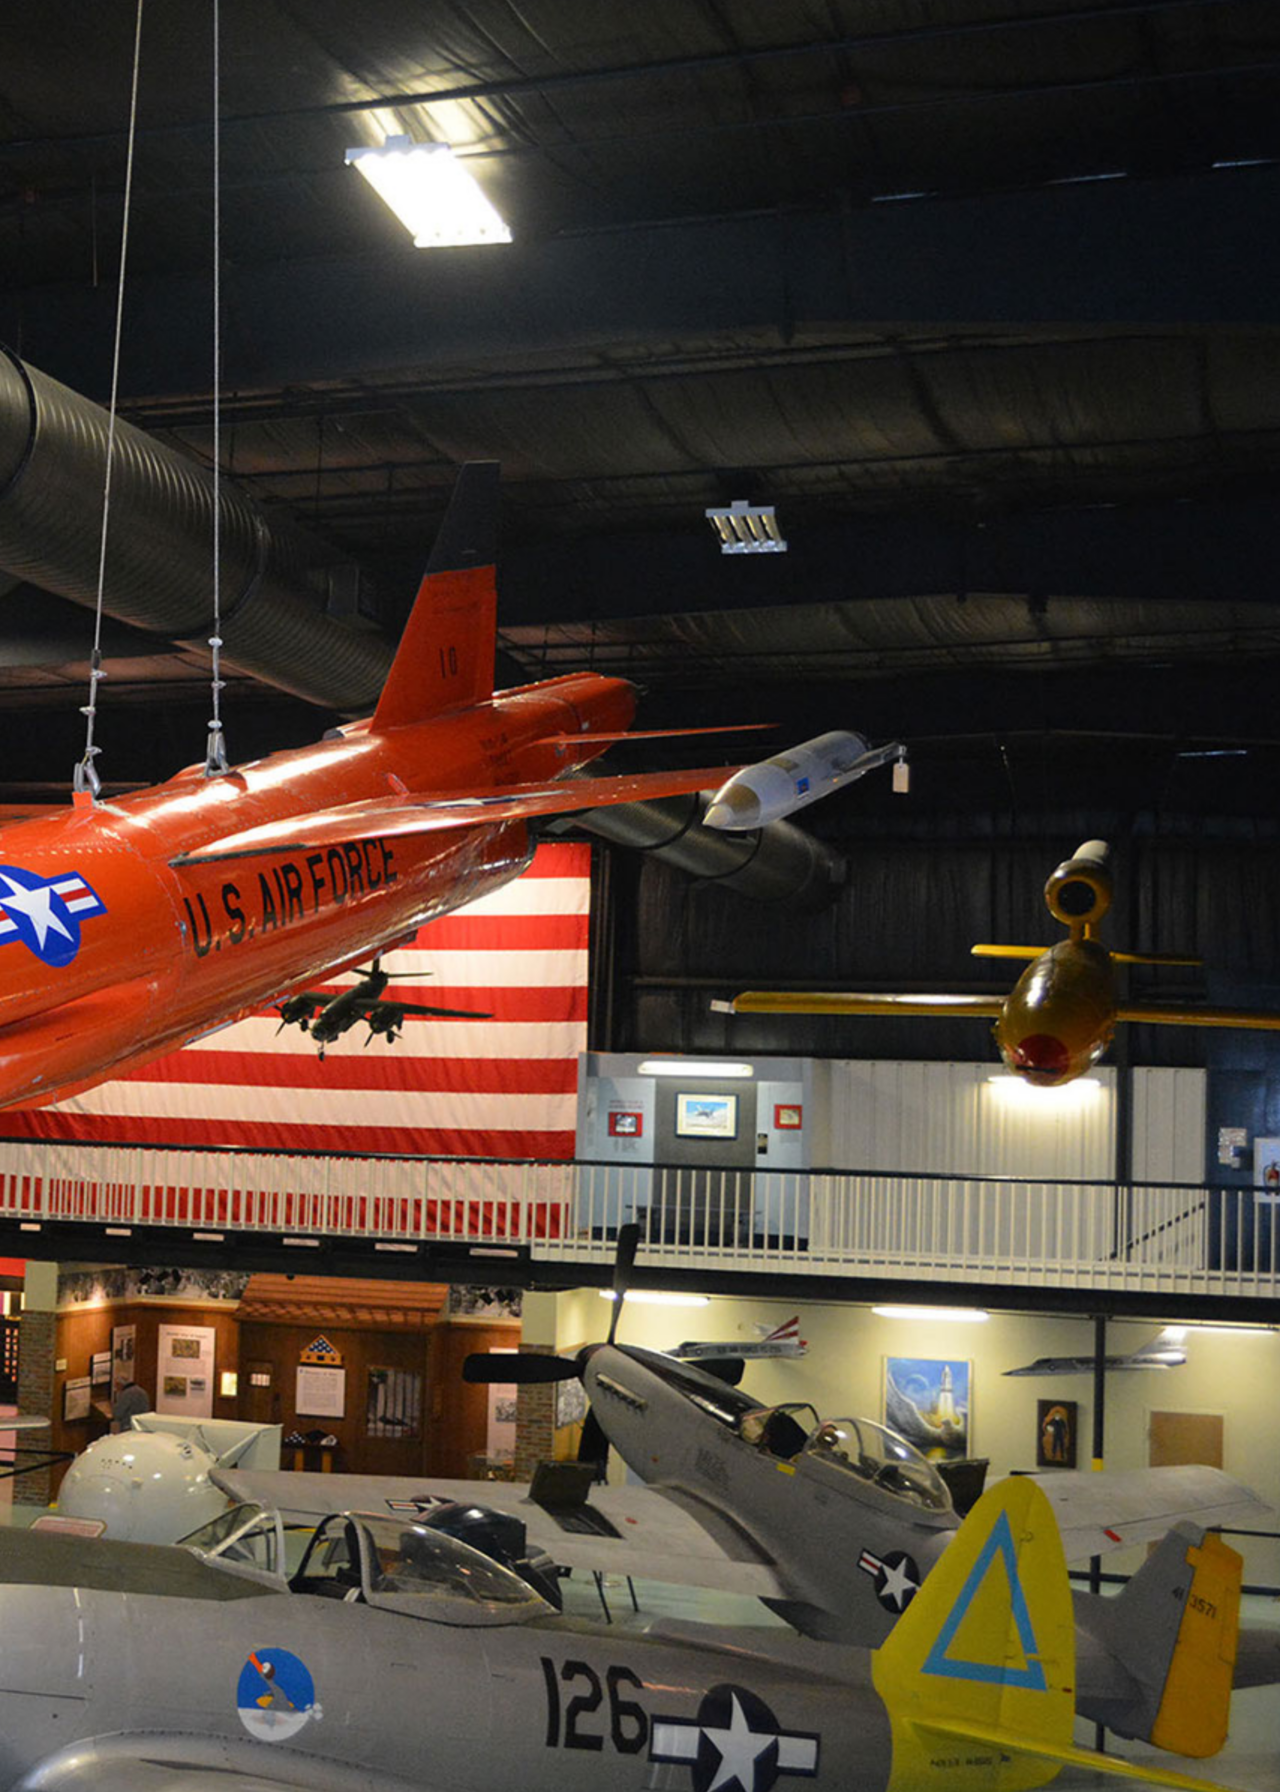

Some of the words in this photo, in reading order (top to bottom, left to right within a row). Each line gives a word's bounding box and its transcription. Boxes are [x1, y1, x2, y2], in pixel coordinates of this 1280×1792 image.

[439, 646, 458, 679] 10
[183, 883, 254, 958] U.S.
[258, 862, 305, 934] AIR
[306, 838, 398, 914] FORCE
[540, 1656, 648, 1755] 126
